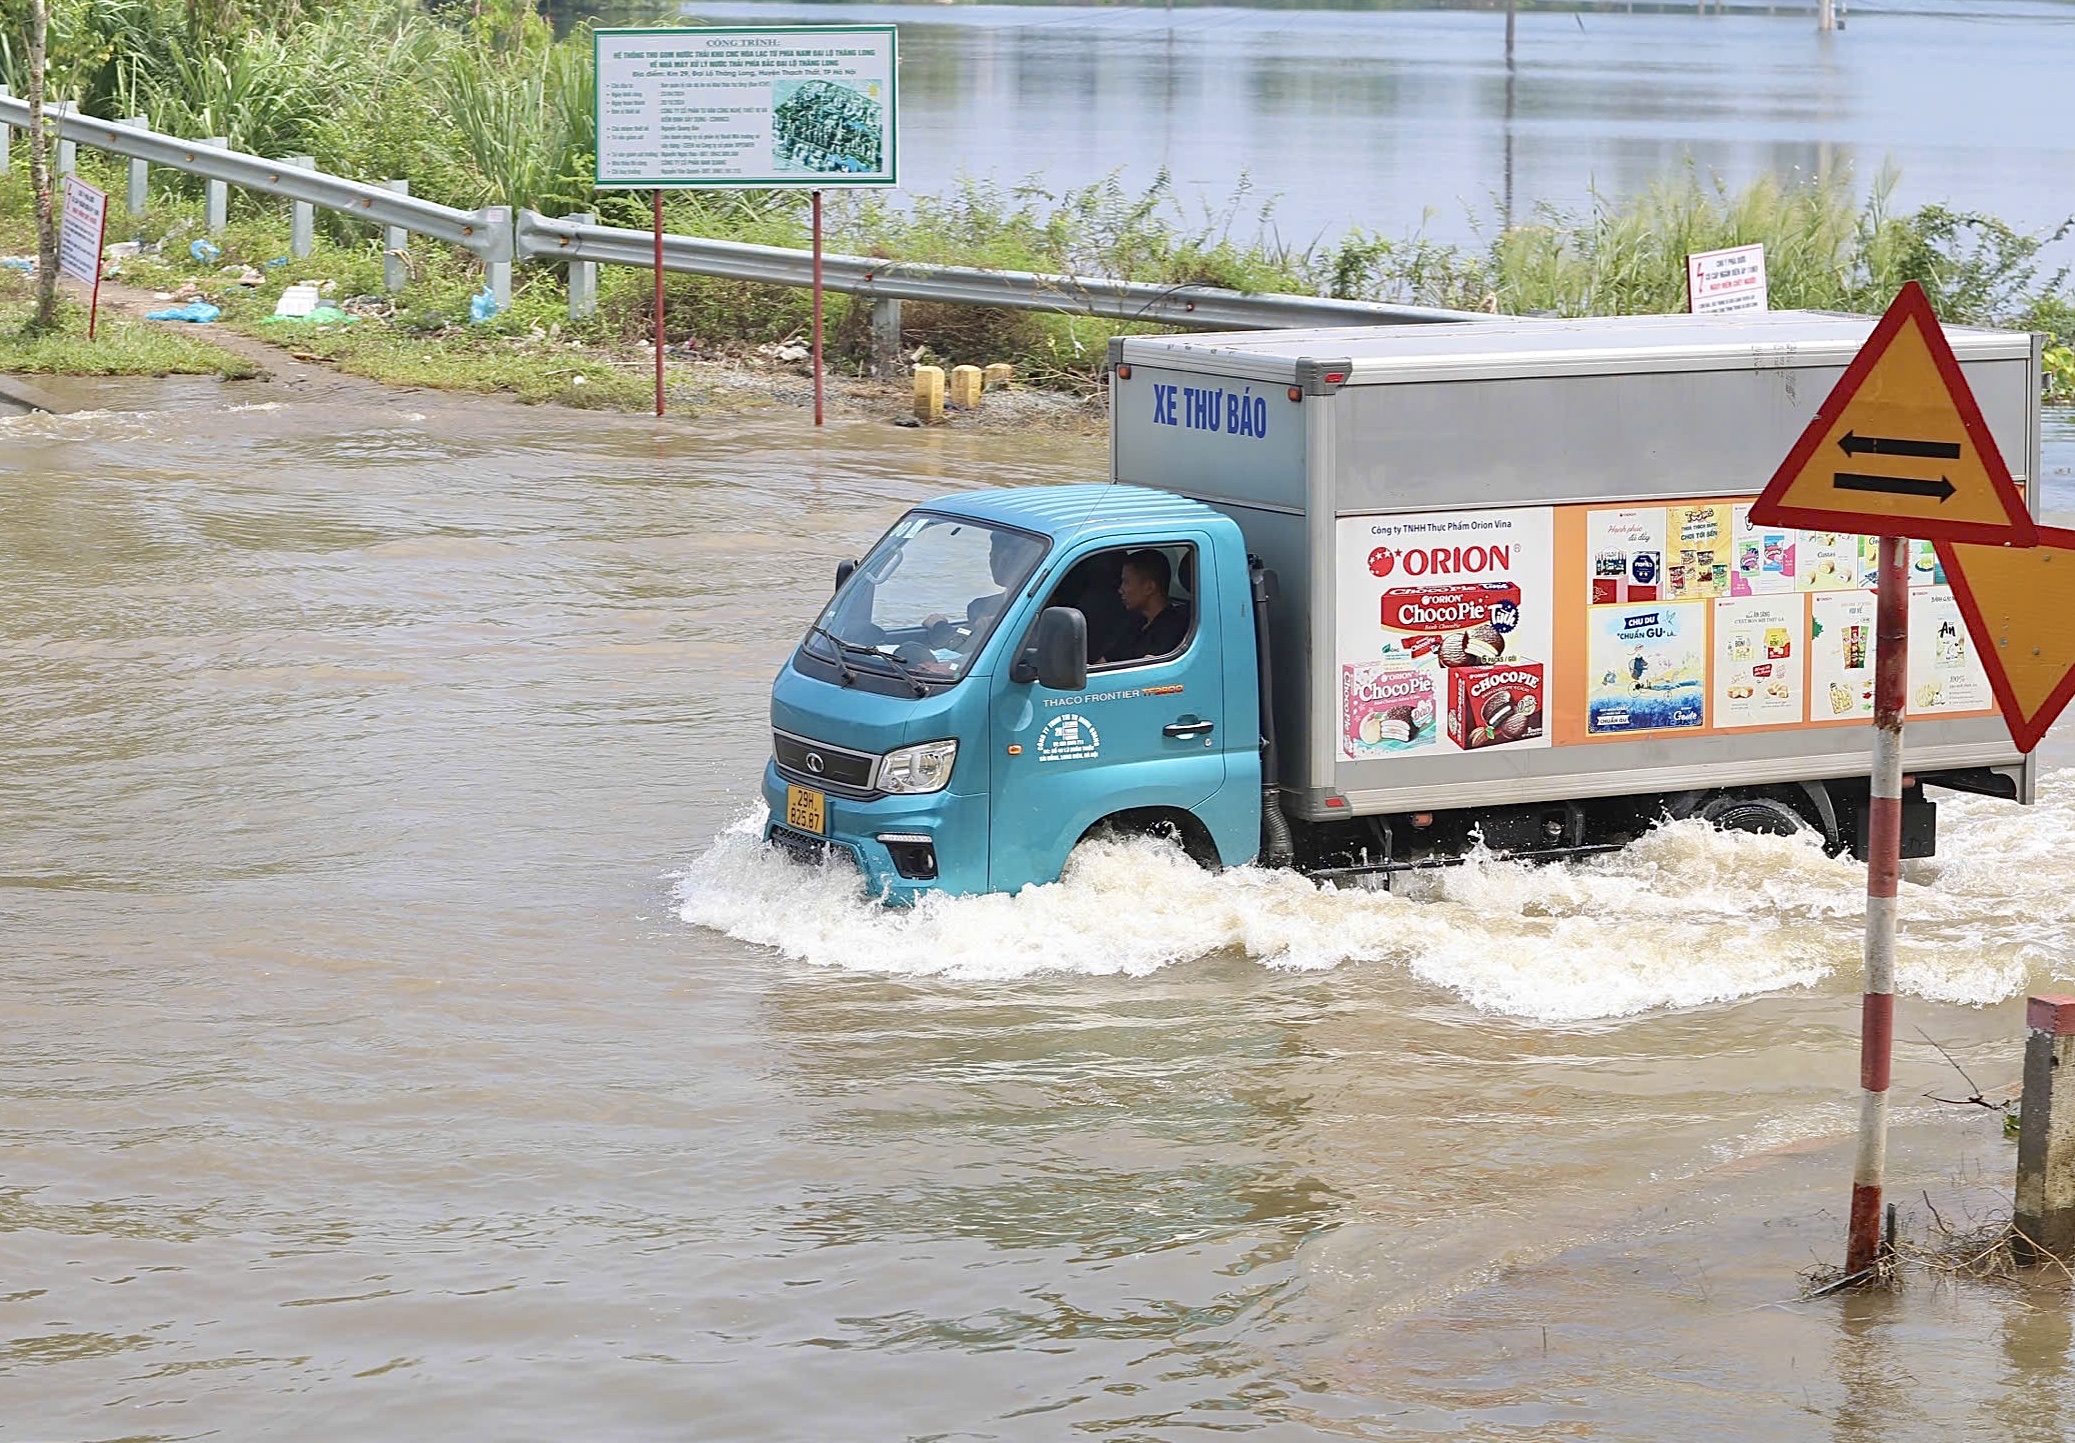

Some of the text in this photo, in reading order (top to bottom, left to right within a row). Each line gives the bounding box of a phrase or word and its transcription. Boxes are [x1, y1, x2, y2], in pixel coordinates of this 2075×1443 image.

[706, 38, 781, 48] CÔNG TRÌNH:
[1153, 383, 1267, 439] XE THƯ BÁO
[1371, 519, 1512, 536] Công ty TNHH Thực Phẩm Orion Vina
[1402, 545, 1509, 576] ORION
[1430, 594, 1461, 604] ORION
[1398, 601, 1484, 625] ChocoPie
[1628, 616, 1656, 627] CHU DU
[1359, 677, 1432, 702] ChocoPie
[1471, 671, 1540, 697] CHOCOPIE
[1043, 695, 1083, 708] THACO
[1084, 690, 1140, 704] FRONTIER
[797, 790, 814, 808] 29H
[790, 807, 820, 830] 825.87
